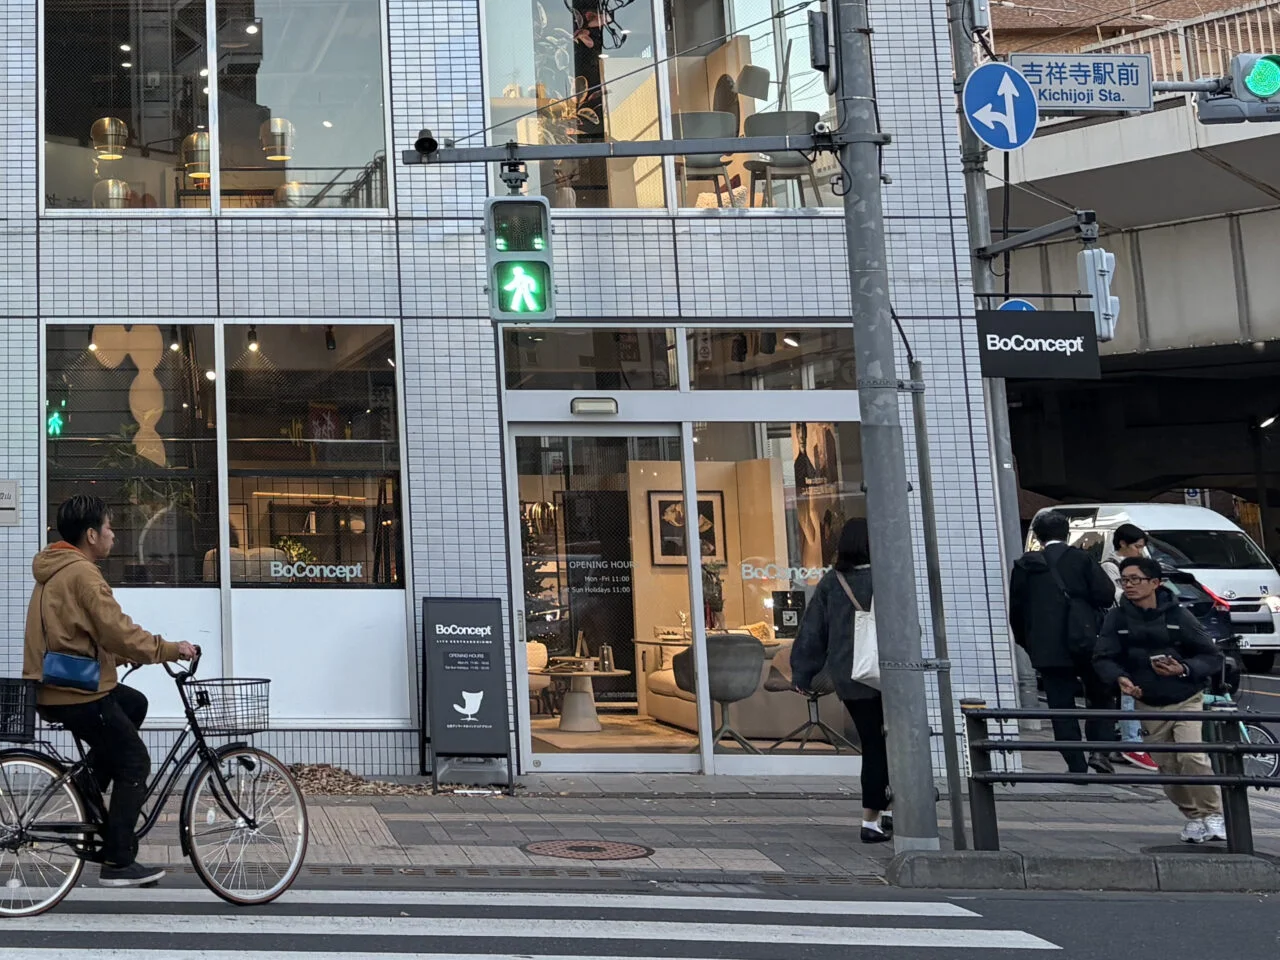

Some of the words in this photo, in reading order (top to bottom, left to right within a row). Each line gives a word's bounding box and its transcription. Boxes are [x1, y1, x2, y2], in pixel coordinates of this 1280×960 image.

[1021, 61, 1140, 87] 吉祥寺駅前
[1038, 88, 1094, 104] Kichijoji
[1098, 89, 1125, 102] Sta.
[986, 334, 1084, 356] BoConcept
[270, 561, 363, 582] BoConcept
[569, 561, 608, 569] OPENING
[435, 624, 492, 637] BoConcept
